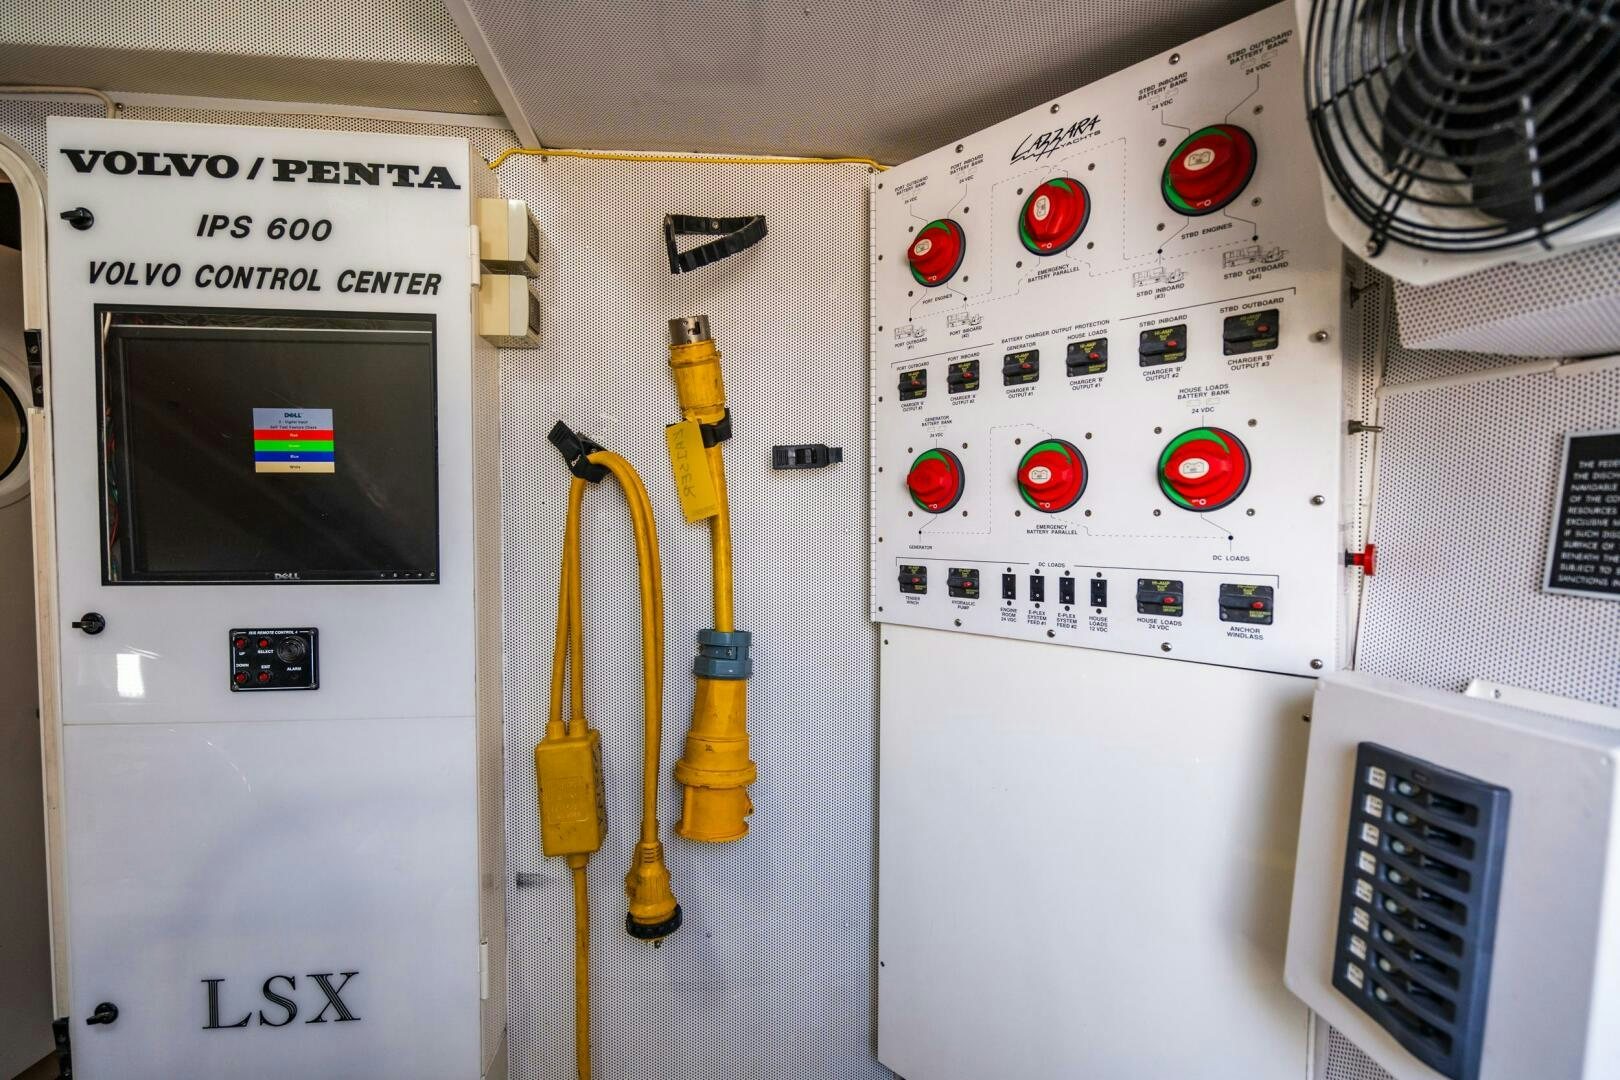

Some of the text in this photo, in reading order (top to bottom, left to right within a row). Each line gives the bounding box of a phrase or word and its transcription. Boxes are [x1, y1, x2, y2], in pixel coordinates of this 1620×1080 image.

[1227, 30, 1293, 60] STBD OUTBOARD
[1230, 39, 1288, 65] BATTERY BANK
[1256, 61, 1271, 71] VDC
[1138, 78, 1188, 101] BATTERY BANK
[1139, 72, 1188, 95] STBD INBOARD
[1160, 99, 1173, 107] VDC
[1061, 130, 1100, 147] YACHTS
[964, 154, 983, 164] INBOARD
[60, 149, 239, 179] VOLVO
[272, 159, 461, 189] PENTA
[950, 165, 969, 175] BATTERY
[895, 176, 928, 192] PORT OUTBOARD
[897, 186, 914, 195] BATTERY
[196, 214, 332, 241] IPS 600
[1181, 223, 1232, 240] STBD ENGINES
[1028, 267, 1079, 283] BATTERY PARALLEL
[1038, 264, 1069, 275] EMERGENCY
[1224, 262, 1288, 279] STBD OUTBOARD
[89, 261, 442, 296] VOLVO CONTROL CENTER
[1136, 283, 1185, 297] STBD INBOARD
[1220, 298, 1284, 313] STBD OUTBOARD
[1139, 315, 1188, 328] STBD INBOARD
[1001, 320, 1109, 344] BATTERY CHARGER OUTPUT PROTECTION
[906, 338, 927, 346] OUTBOARD
[1007, 342, 1036, 351] GENERATOR
[1228, 356, 1262, 365] CHARGER
[1143, 368, 1174, 376] CHARGER
[1178, 391, 1207, 400] BATTERY
[1227, 632, 1264, 640] WINDLASS
[201, 972, 361, 1030] LSX
